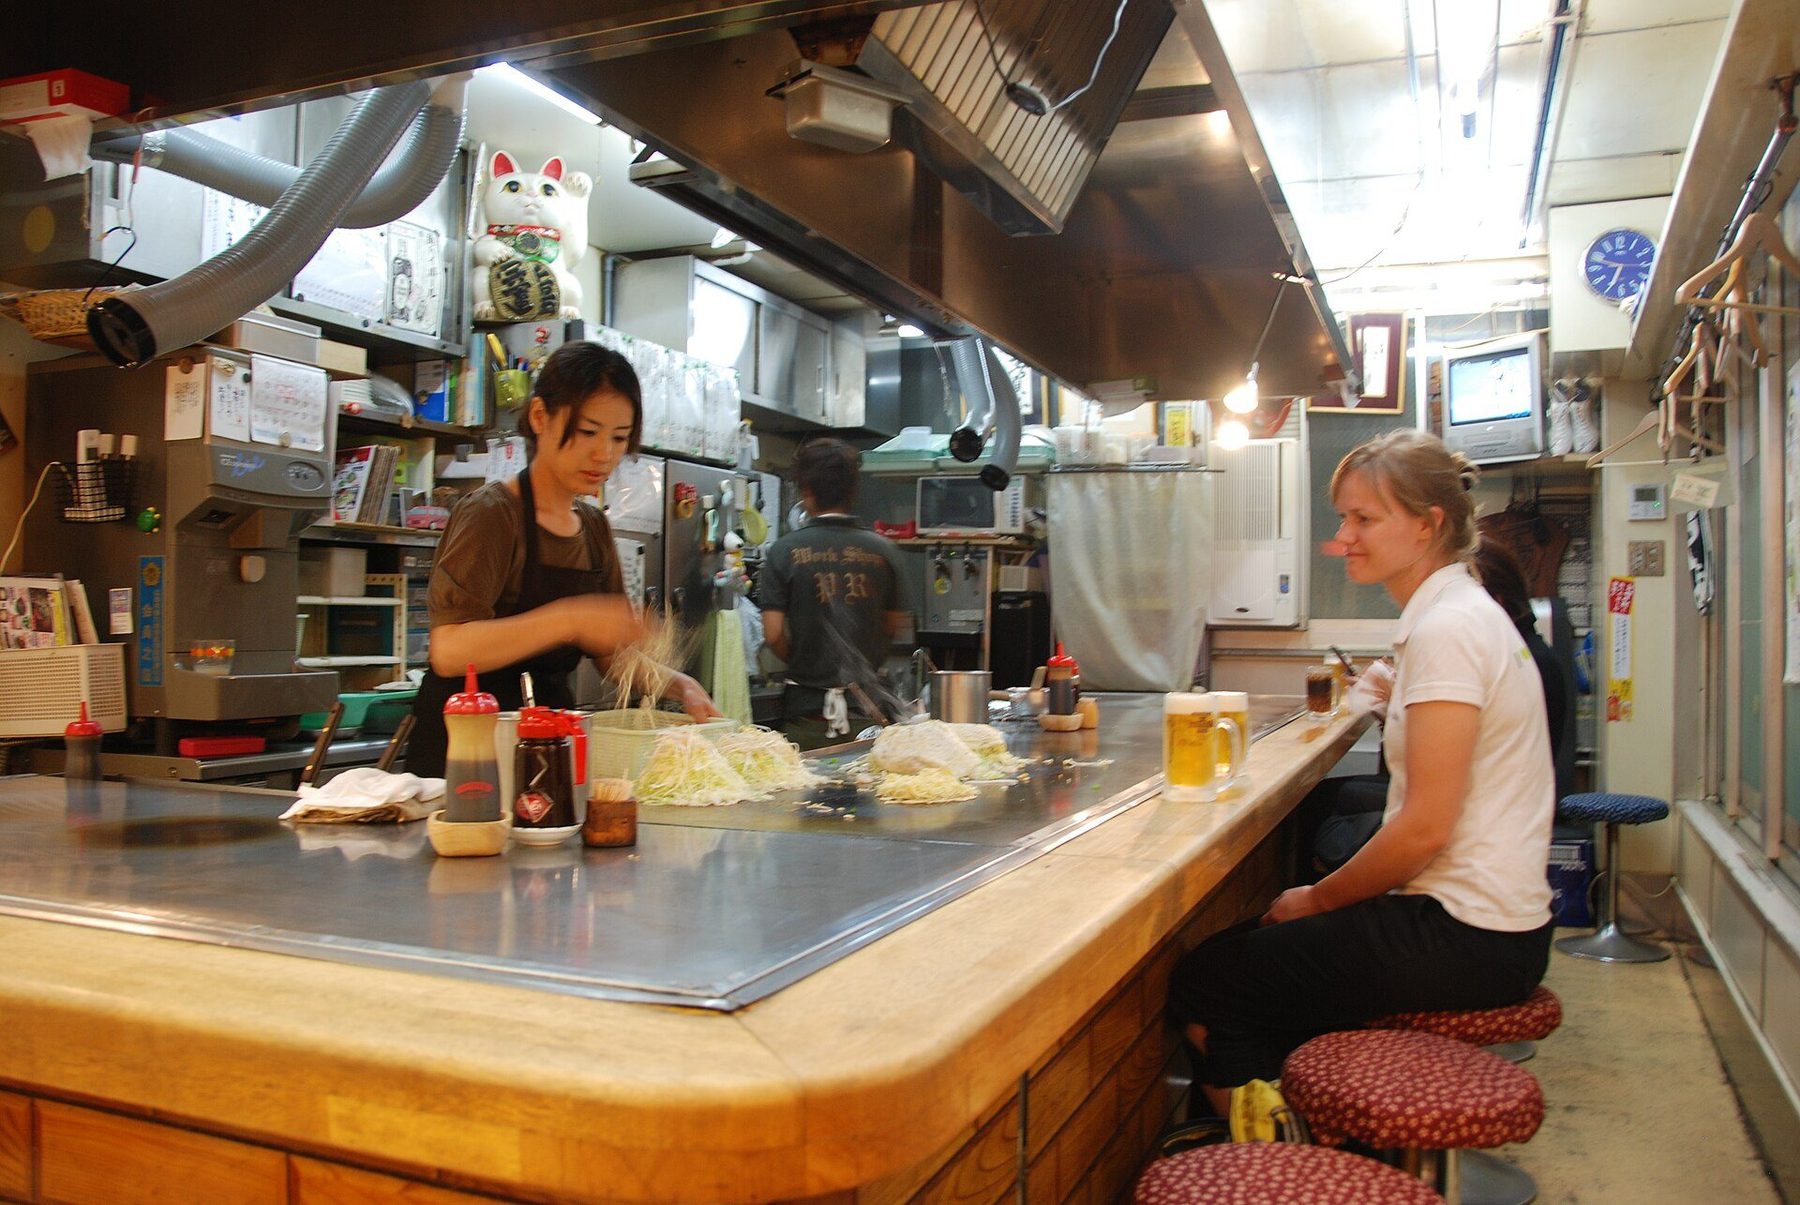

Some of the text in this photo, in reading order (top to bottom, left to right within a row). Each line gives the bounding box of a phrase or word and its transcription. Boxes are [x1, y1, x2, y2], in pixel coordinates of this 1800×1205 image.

[1615, 236, 1625, 250] 12
[1629, 238, 1638, 250] 1
[1636, 247, 1650, 258] 2
[1618, 283, 1625, 297] 6
